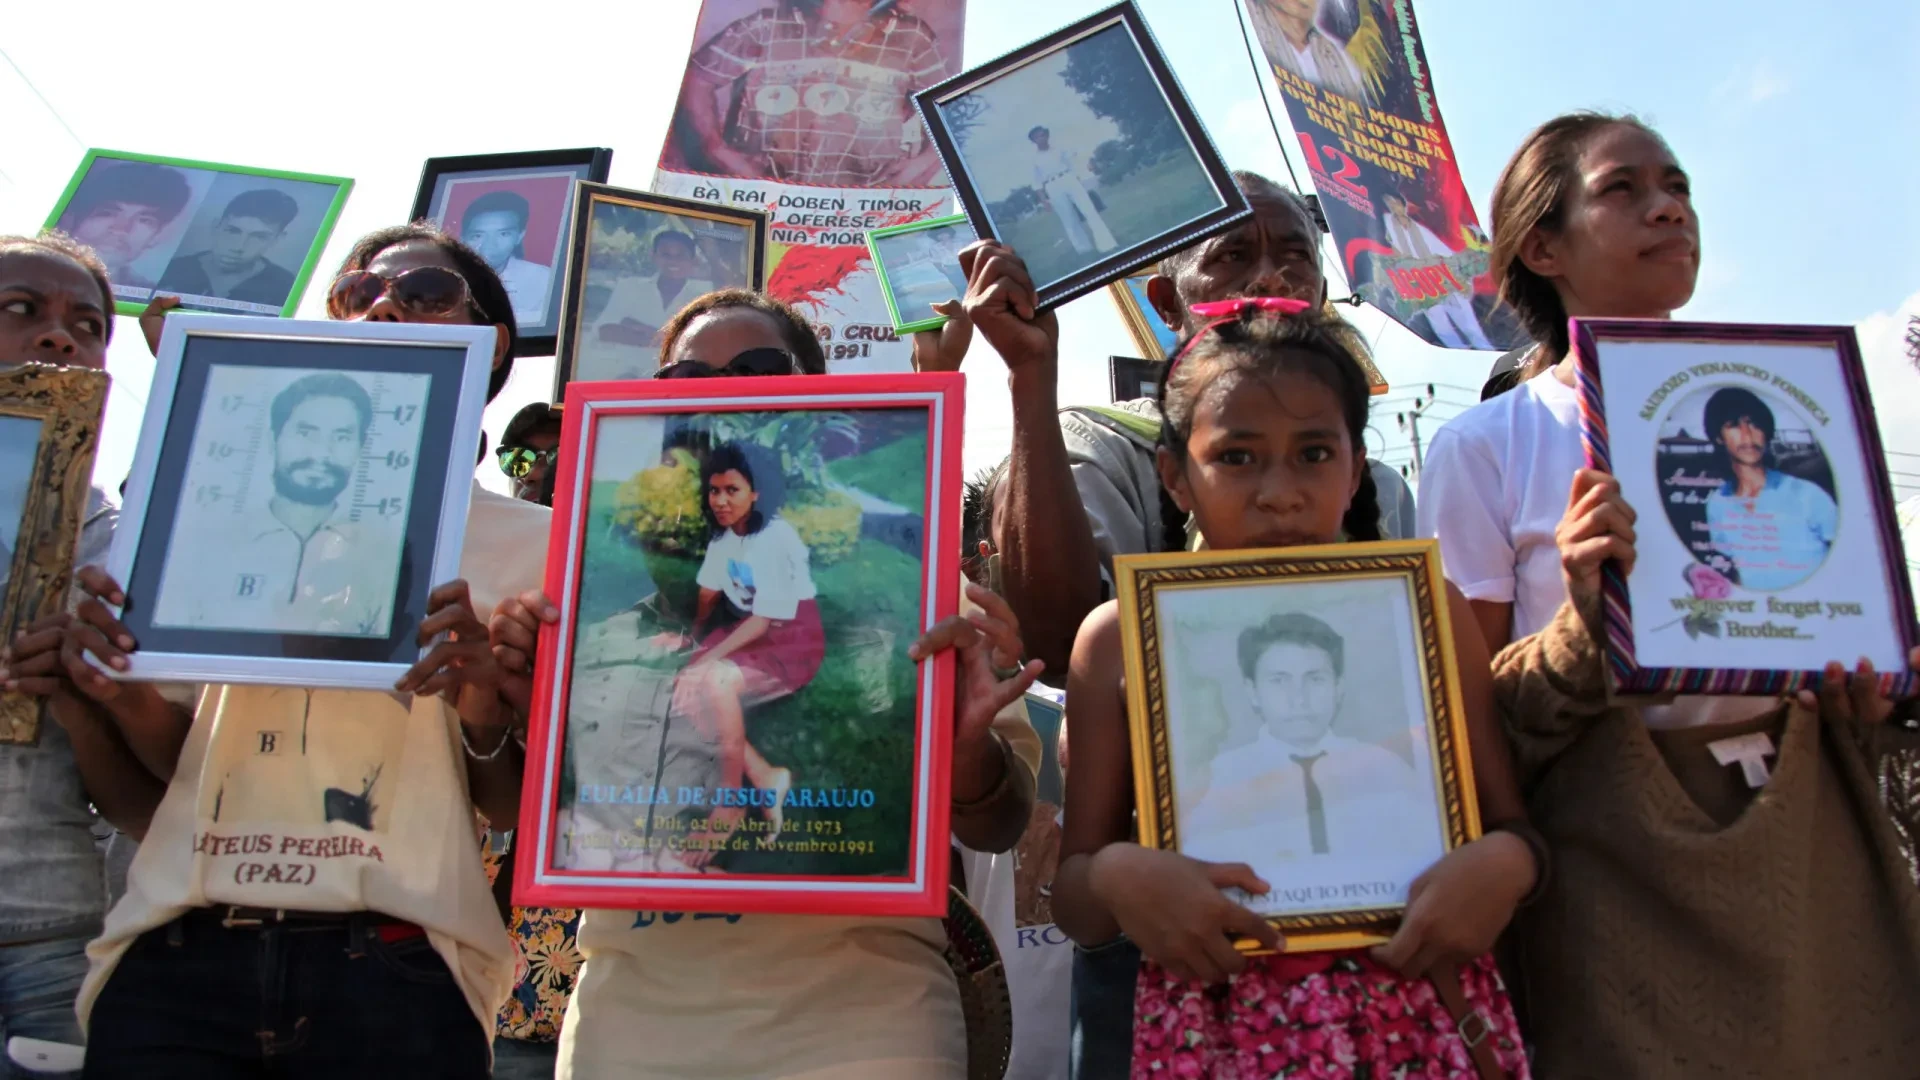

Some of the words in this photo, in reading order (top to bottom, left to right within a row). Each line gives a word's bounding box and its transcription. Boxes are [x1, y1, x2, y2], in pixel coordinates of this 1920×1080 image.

[1323, 89, 1363, 116] NIA
[1368, 107, 1442, 144] MORIS
[1305, 106, 1347, 137] RAI
[1352, 129, 1431, 170] DOBEN
[1338, 136, 1417, 180] TIMOR
[1414, 138, 1448, 162] BA
[1296, 132, 1369, 199] 12
[693, 186, 720, 200] BA
[732, 190, 766, 204] RAI
[778, 195, 846, 212] DOBEN
[858, 199, 922, 212] TIMOR
[787, 213, 876, 229] OFERESE
[771, 229, 807, 242] NIA
[844, 325, 902, 343] CRUZ
[824, 343, 869, 360] 1991
[237, 575, 257, 597] B
[1766, 596, 1823, 619] forget
[1826, 601, 1864, 619] you
[260, 733, 276, 753] B
[676, 785, 706, 806] DE
[711, 786, 777, 808] JESUS
[713, 817, 731, 831] de
[736, 818, 777, 832] Abril
[782, 820, 801, 833] de
[805, 819, 843, 835] 1973
[731, 836, 751, 850] de
[234, 861, 317, 886] (PAZ)
[1342, 881, 1396, 899] PINTO
